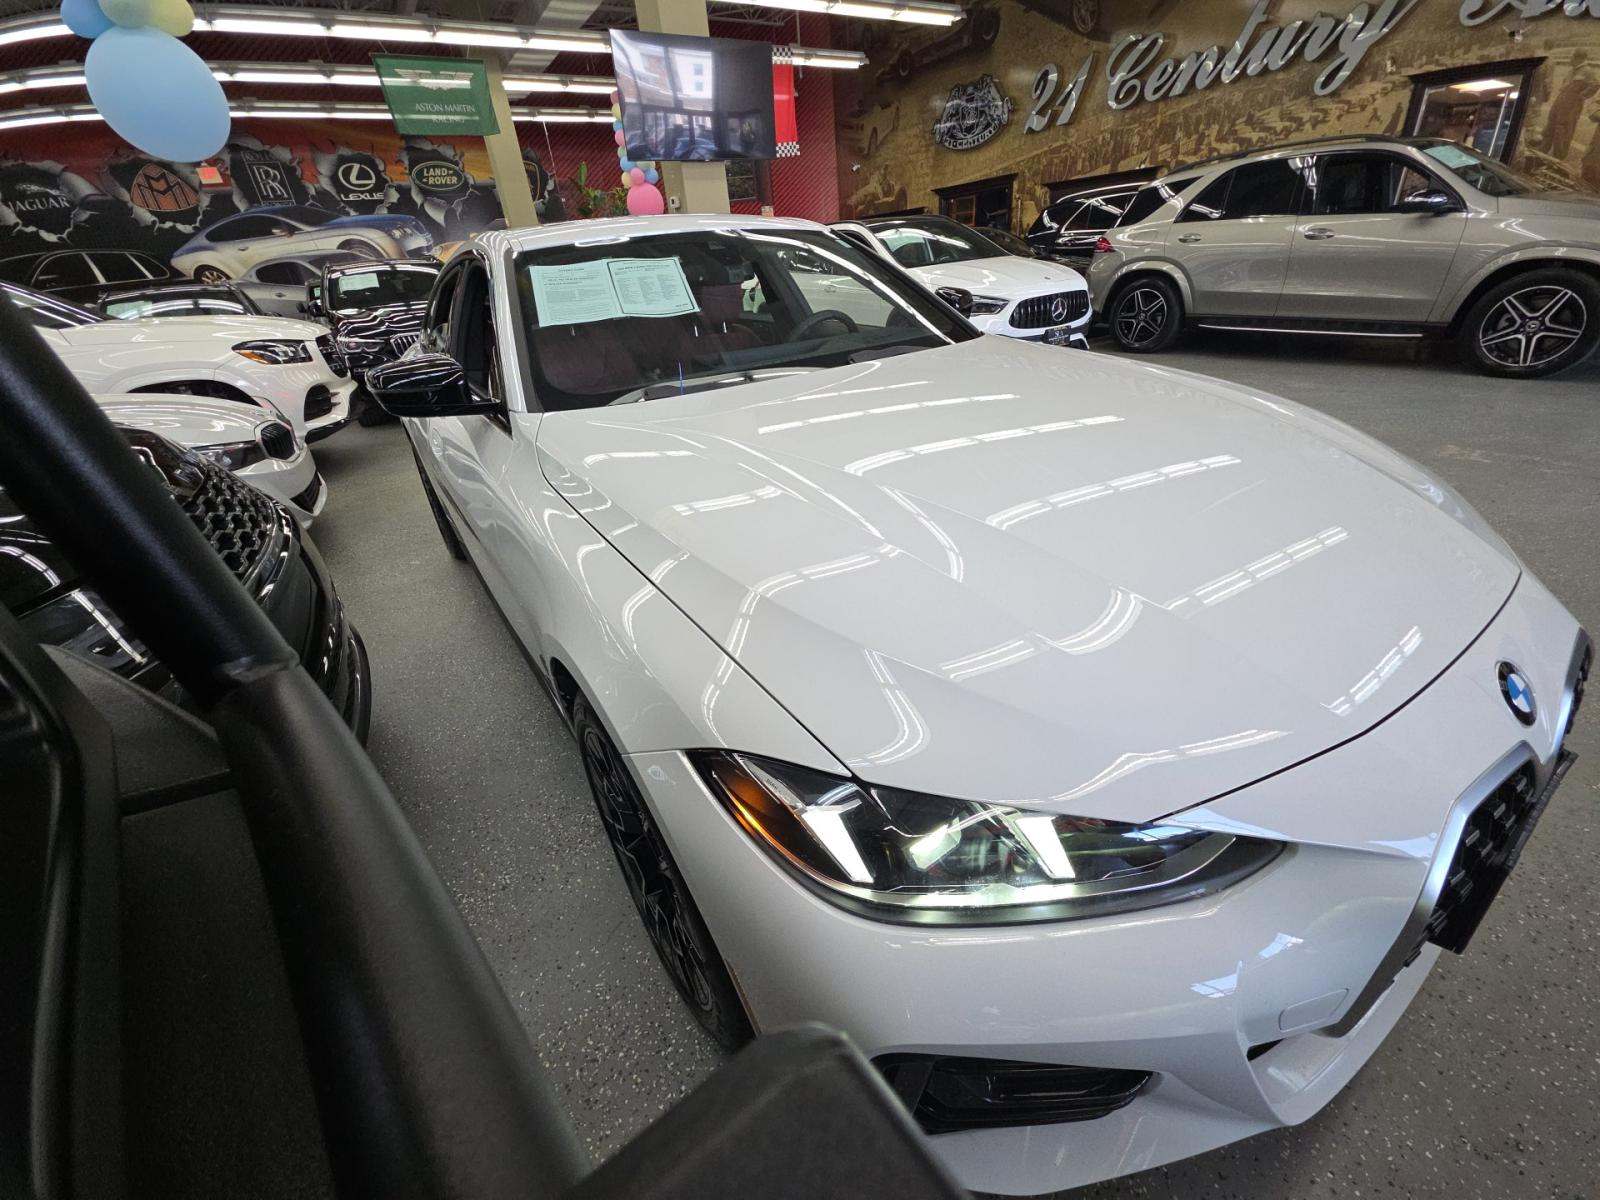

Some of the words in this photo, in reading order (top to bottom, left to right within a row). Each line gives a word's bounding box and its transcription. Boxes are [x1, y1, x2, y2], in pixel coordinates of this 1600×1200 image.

[1106, 0, 1418, 110] Century
[415, 103, 443, 112] ASTON
[445, 103, 475, 113] MARTIN
[428, 176, 458, 185] ROVER
[340, 192, 385, 200] LEXUS
[8, 197, 70, 212] JAGUAR
